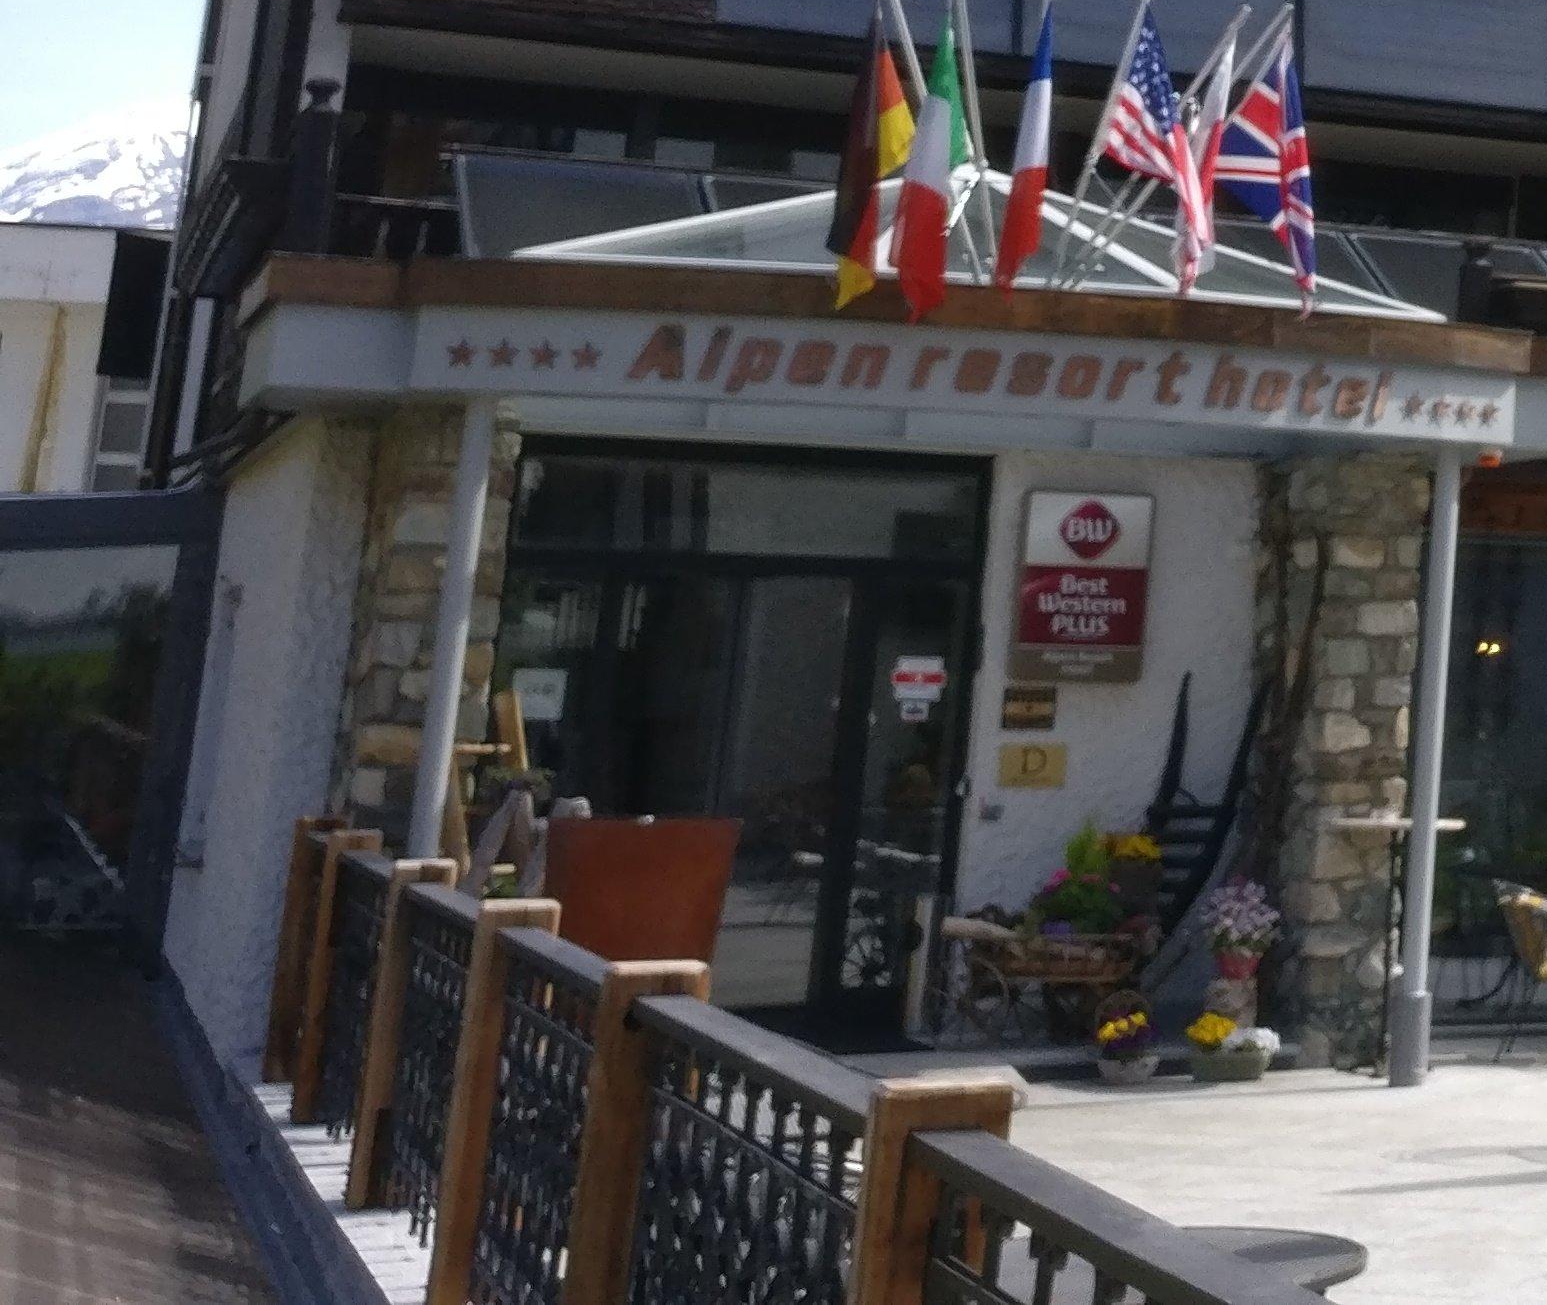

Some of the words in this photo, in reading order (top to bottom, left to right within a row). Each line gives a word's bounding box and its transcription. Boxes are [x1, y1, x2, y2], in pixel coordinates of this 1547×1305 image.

[1202, 353, 1394, 427] hotel
[1060, 574, 1109, 596] Best
[1037, 594, 1127, 615] Western
[1049, 613, 1110, 636] PLUS
